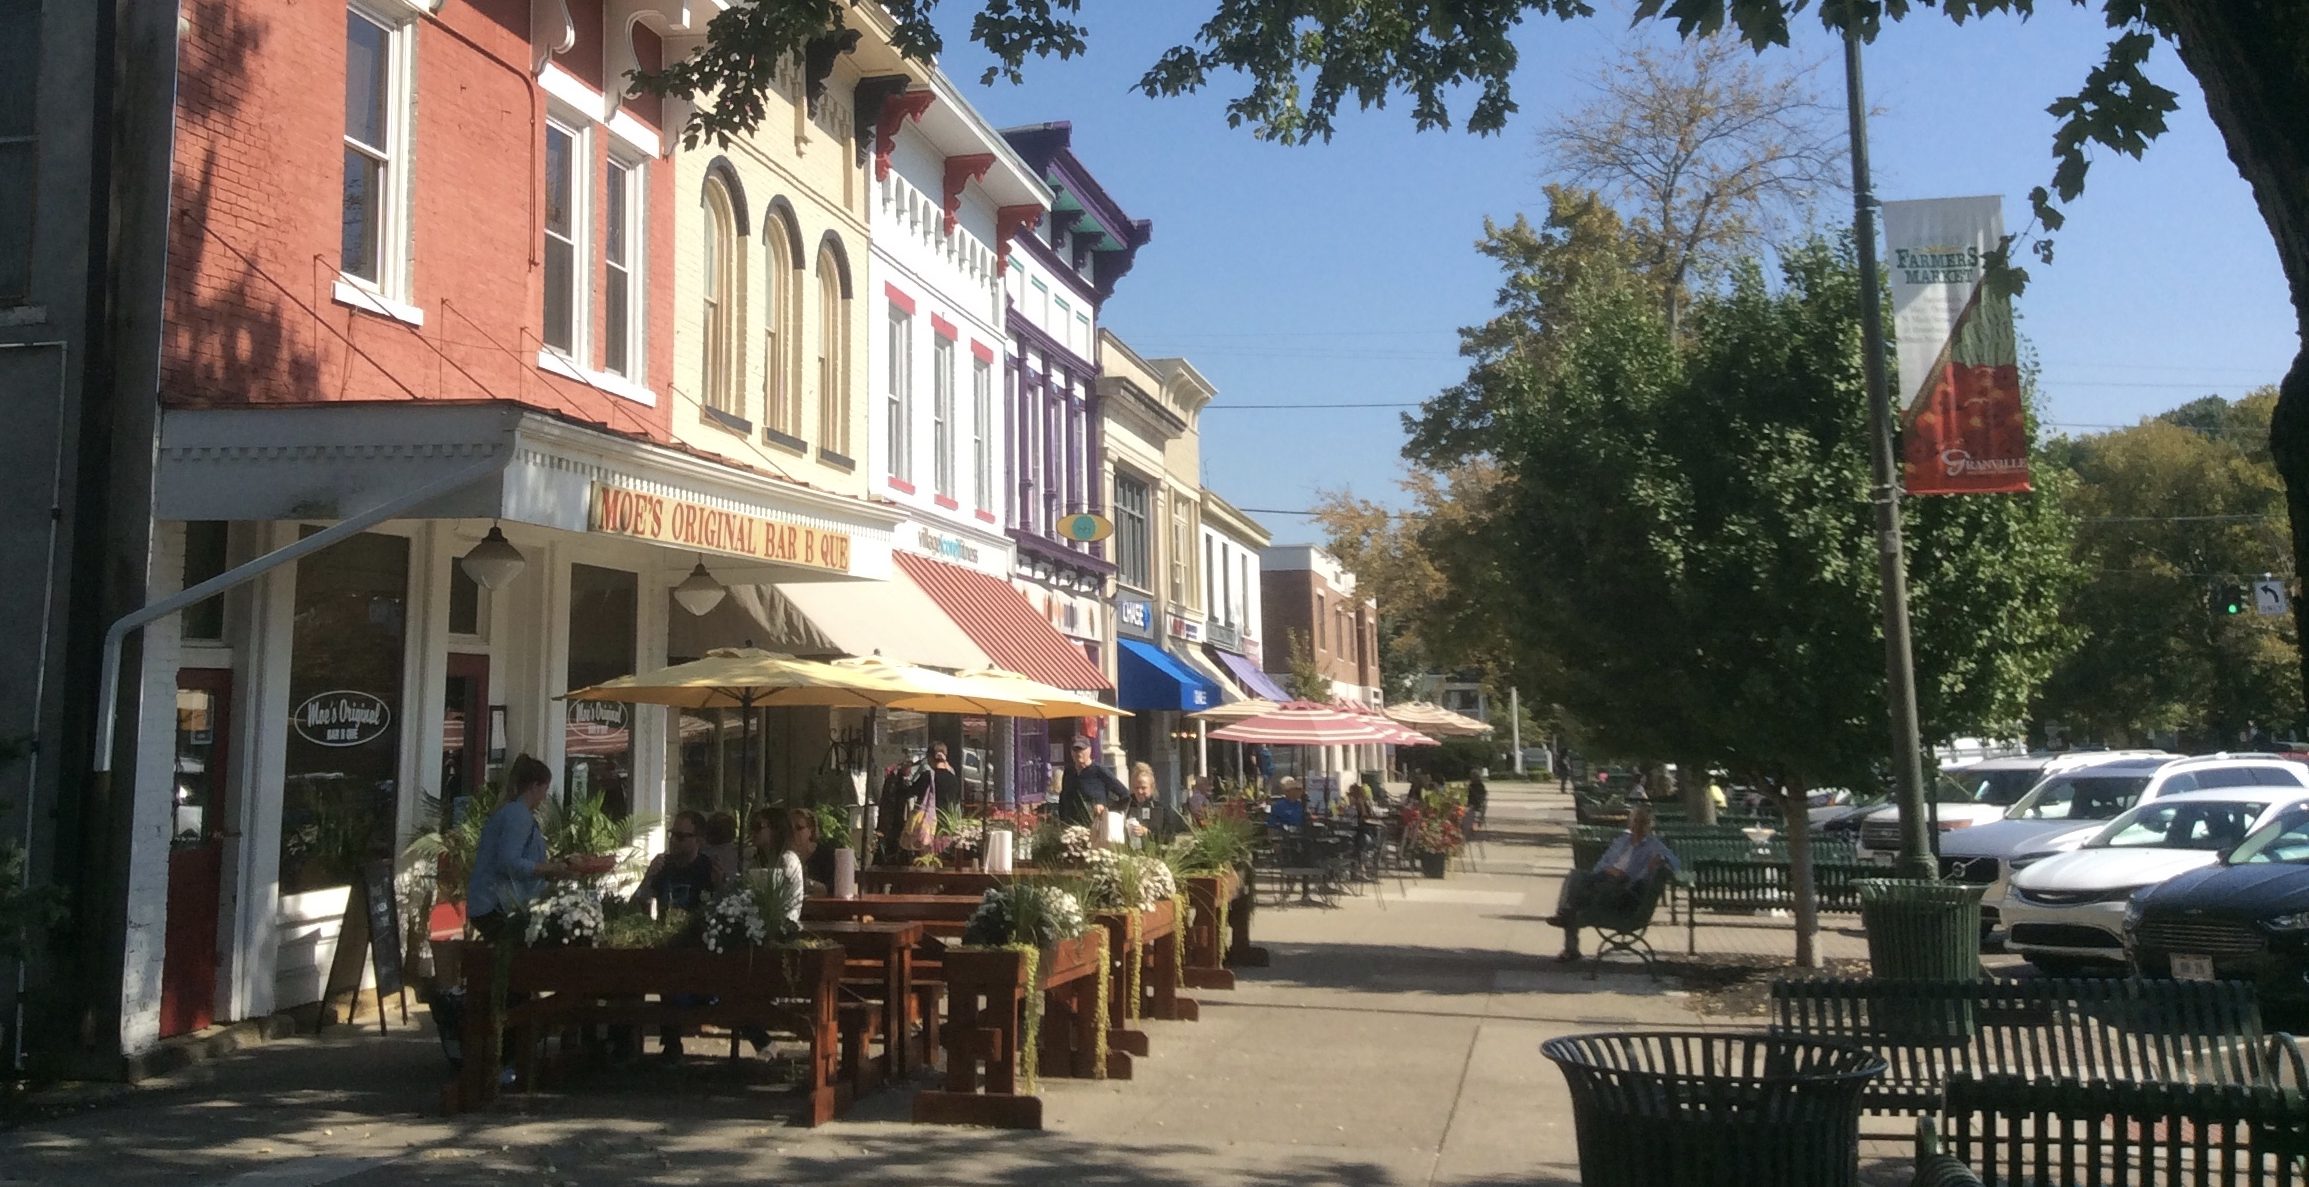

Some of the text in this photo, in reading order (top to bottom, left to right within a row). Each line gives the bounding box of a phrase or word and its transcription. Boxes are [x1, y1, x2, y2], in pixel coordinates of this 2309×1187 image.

[1895, 247, 1978, 268] FARMERS
[1904, 269, 1973, 285] MARKET
[1942, 449, 2028, 476] GRANVILLE
[599, 487, 848, 569] MOE'S ORIGINAL BAR B QUE
[308, 699, 380, 728] Moe's Original
